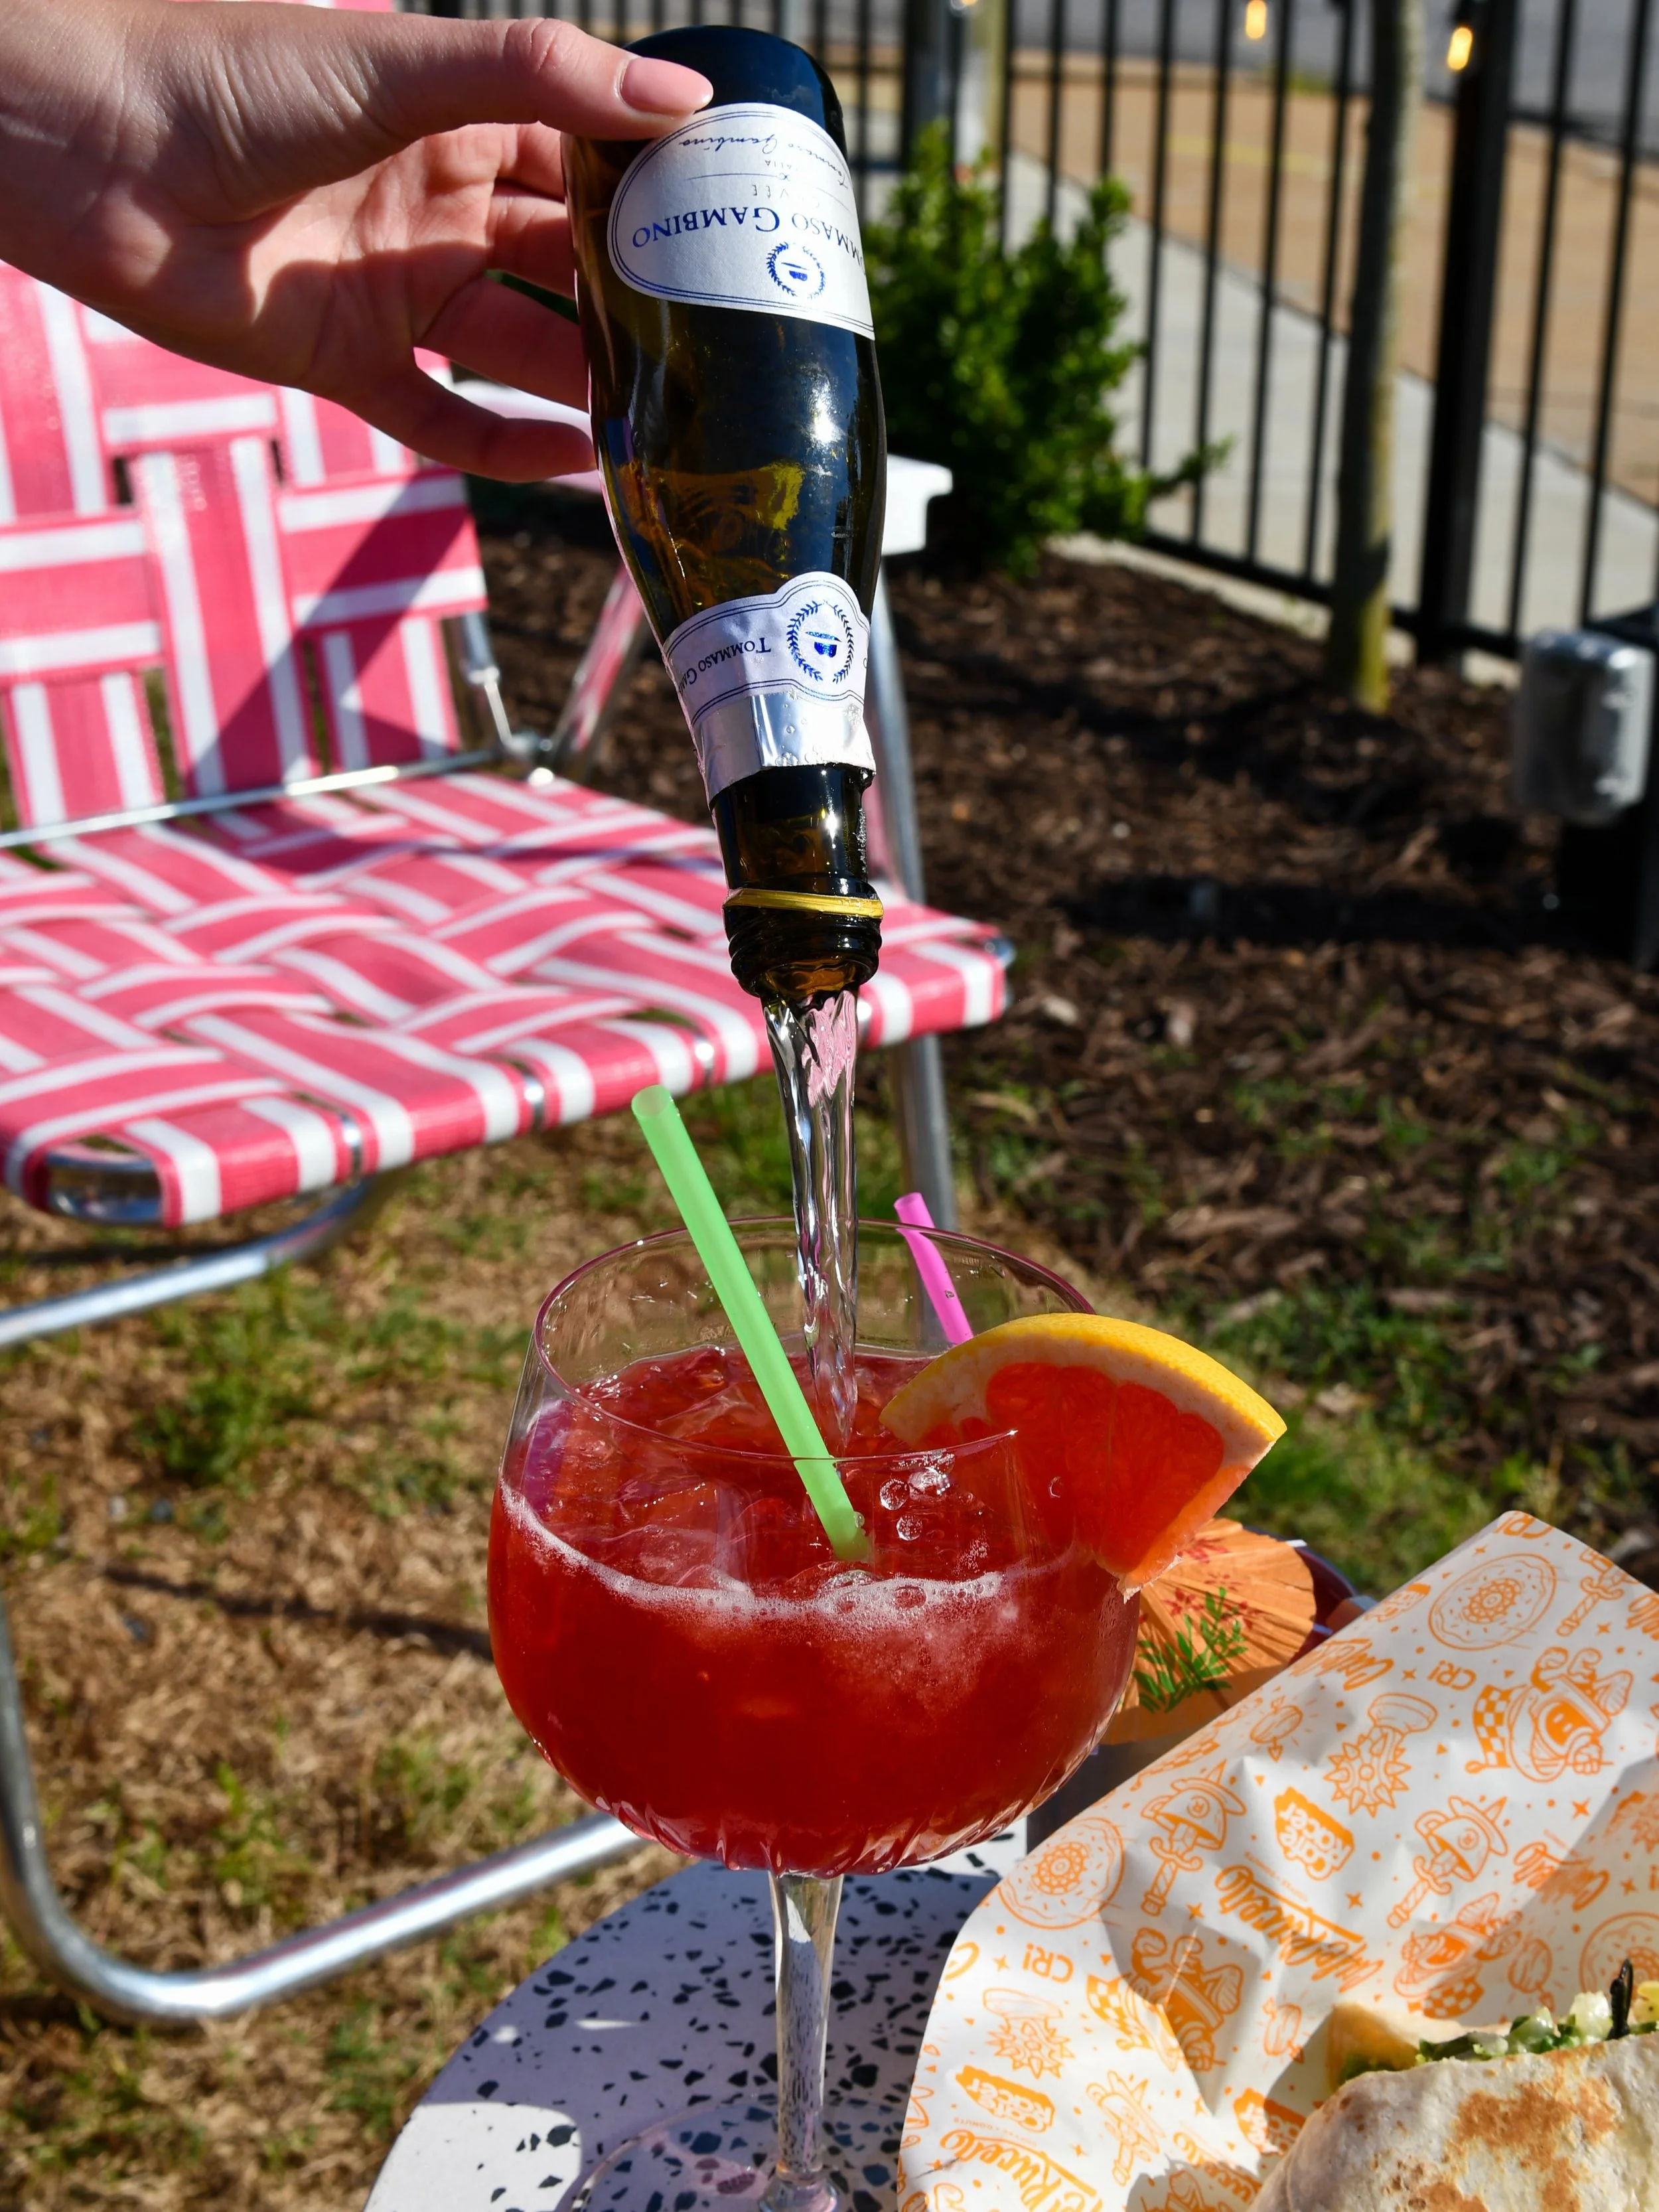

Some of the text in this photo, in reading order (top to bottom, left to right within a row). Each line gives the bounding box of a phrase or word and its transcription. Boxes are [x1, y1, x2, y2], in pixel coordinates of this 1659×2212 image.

[678, 133, 778, 155] Gambino
[632, 206, 865, 276] MMASO GAMBINO
[697, 636, 771, 672] TOMMASO
[1427, 1659, 1477, 1690] CR!
[1023, 1944, 1073, 1983] CR!
